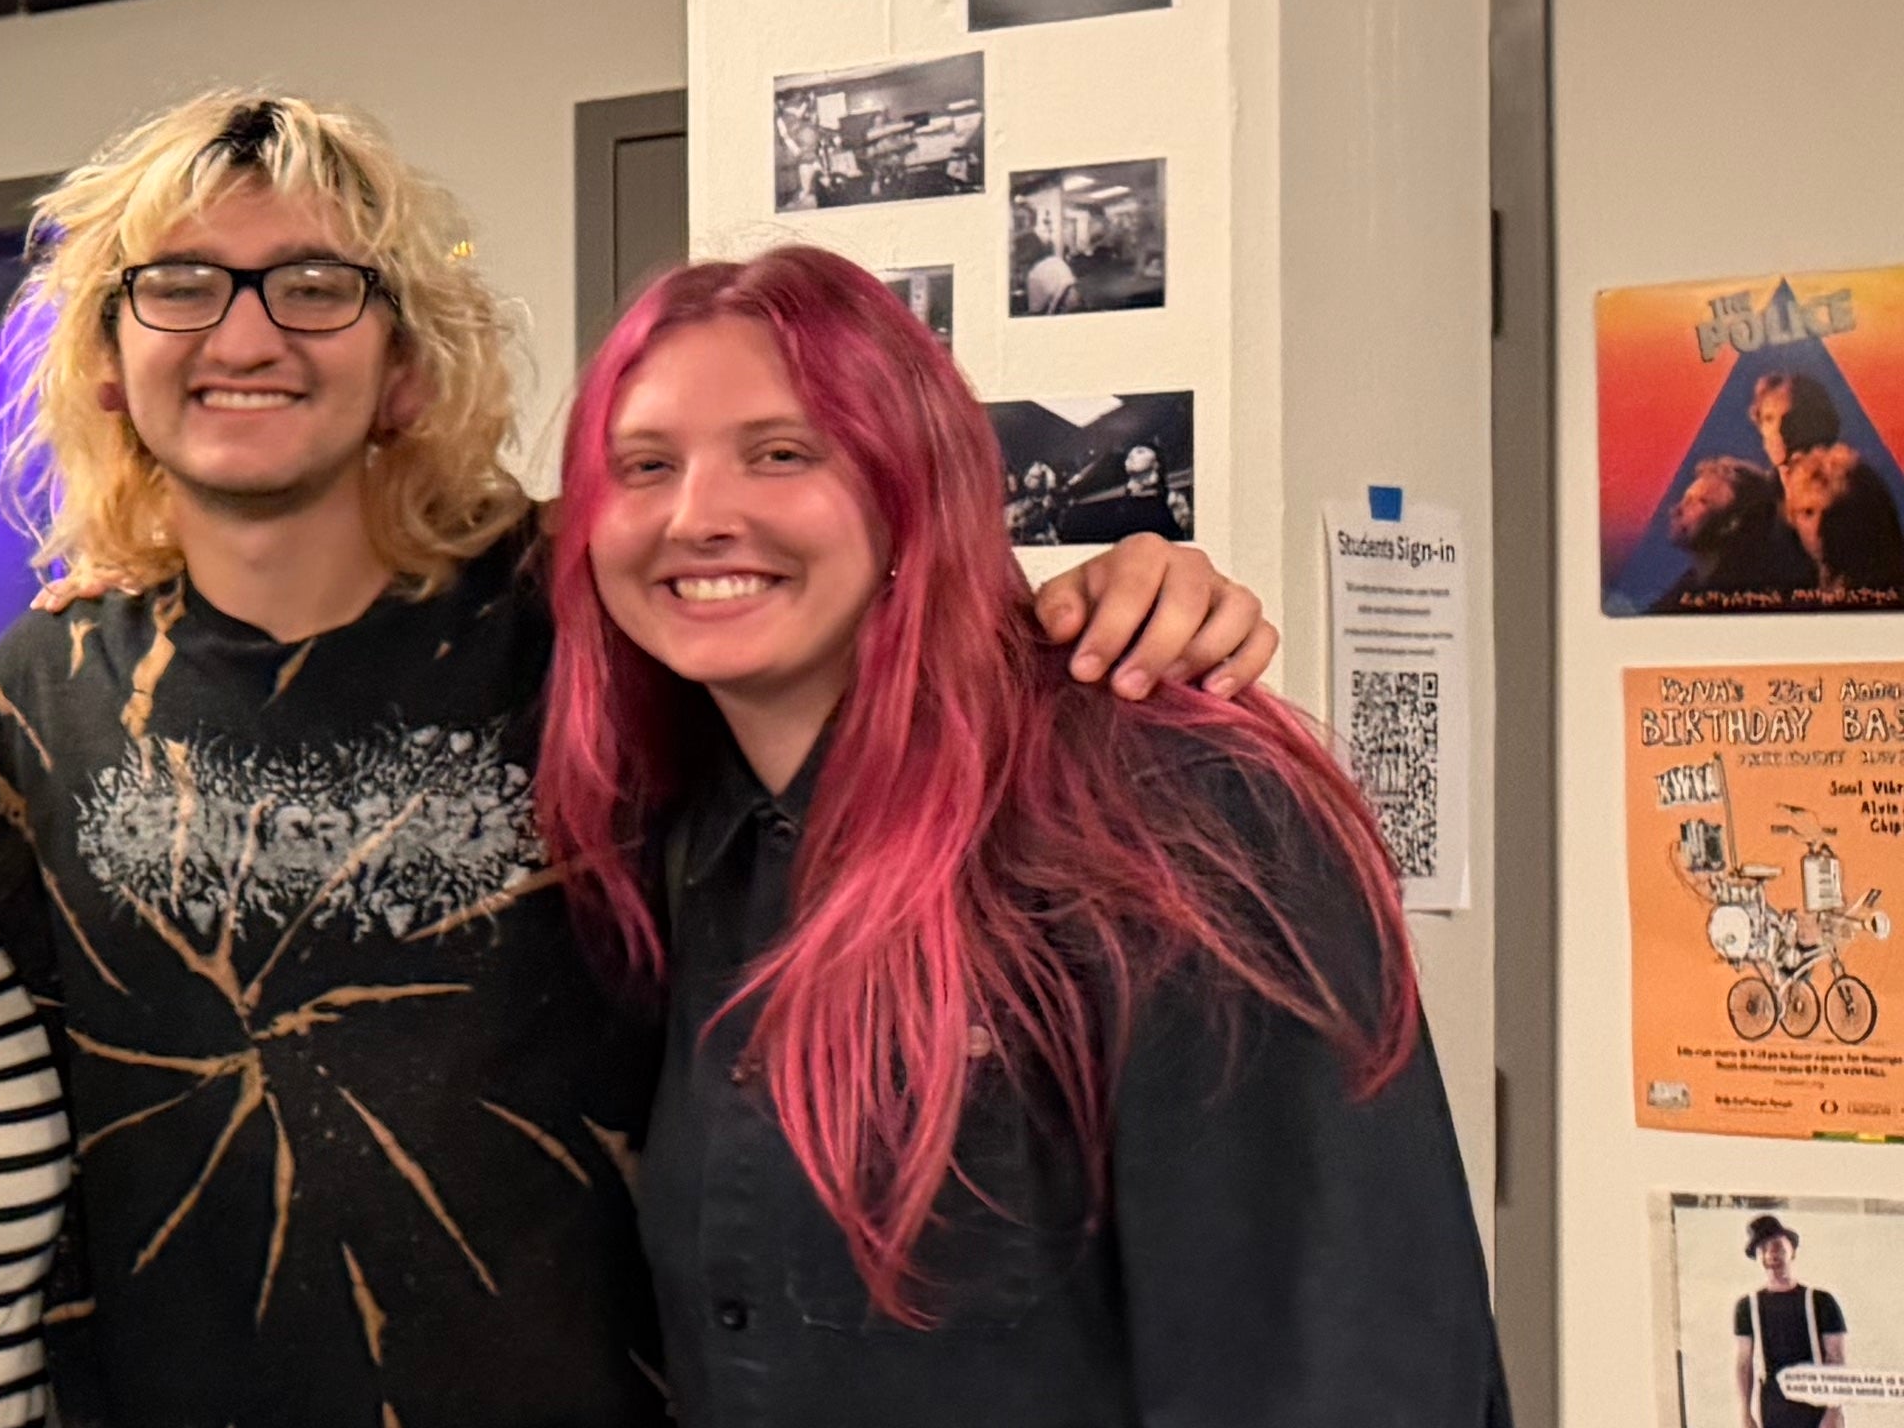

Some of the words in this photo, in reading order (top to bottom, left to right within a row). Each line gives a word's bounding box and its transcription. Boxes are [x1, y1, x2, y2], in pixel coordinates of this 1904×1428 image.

[1337, 530, 1394, 560] Students
[1397, 535, 1455, 568] Sign-in
[1840, 677, 1904, 703] Annu
[1641, 706, 1813, 746] BIRTHDAY
[1872, 780, 1904, 795] Vibr
[1870, 821, 1904, 836] Chip
